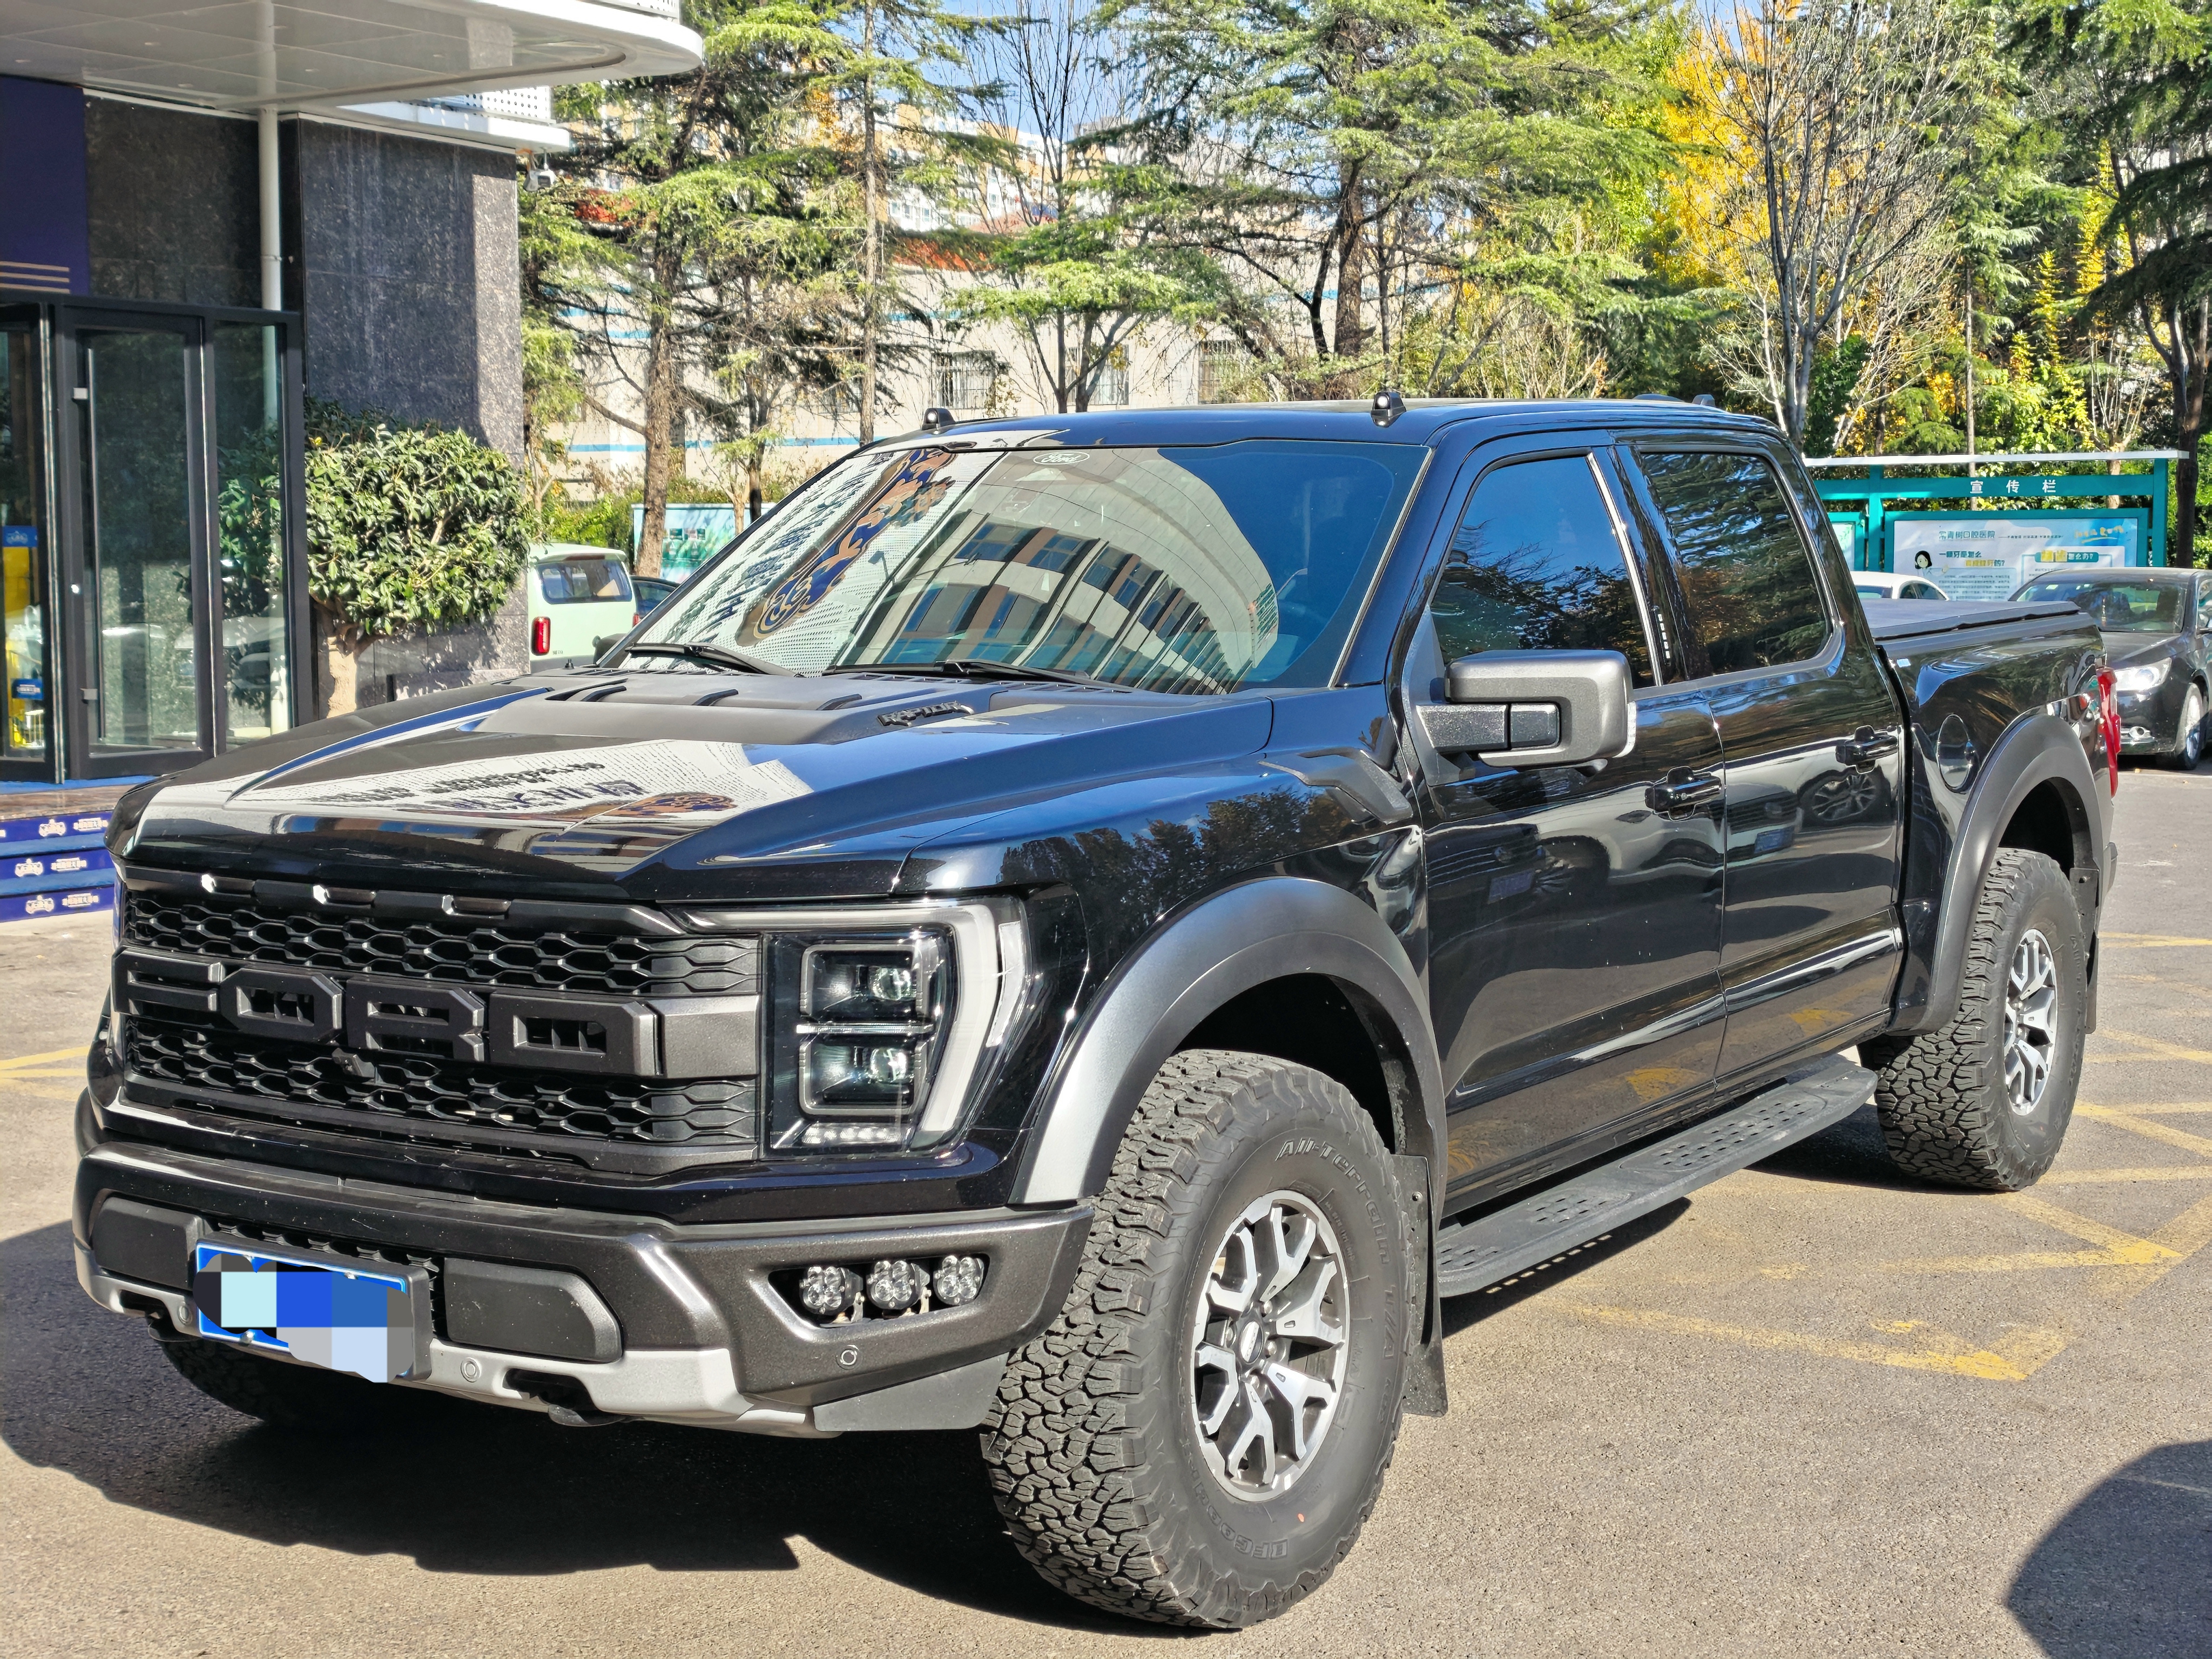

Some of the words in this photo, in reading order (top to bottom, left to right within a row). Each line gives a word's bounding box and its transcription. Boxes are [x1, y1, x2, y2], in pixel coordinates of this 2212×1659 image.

[1041, 453, 1081, 463] Ford
[1970, 479, 2056, 494] 宣传栏
[876, 700, 975, 727] RAPTOR
[112, 943, 662, 1077] FORD
[1274, 1137, 1391, 1265] All-Terrain
